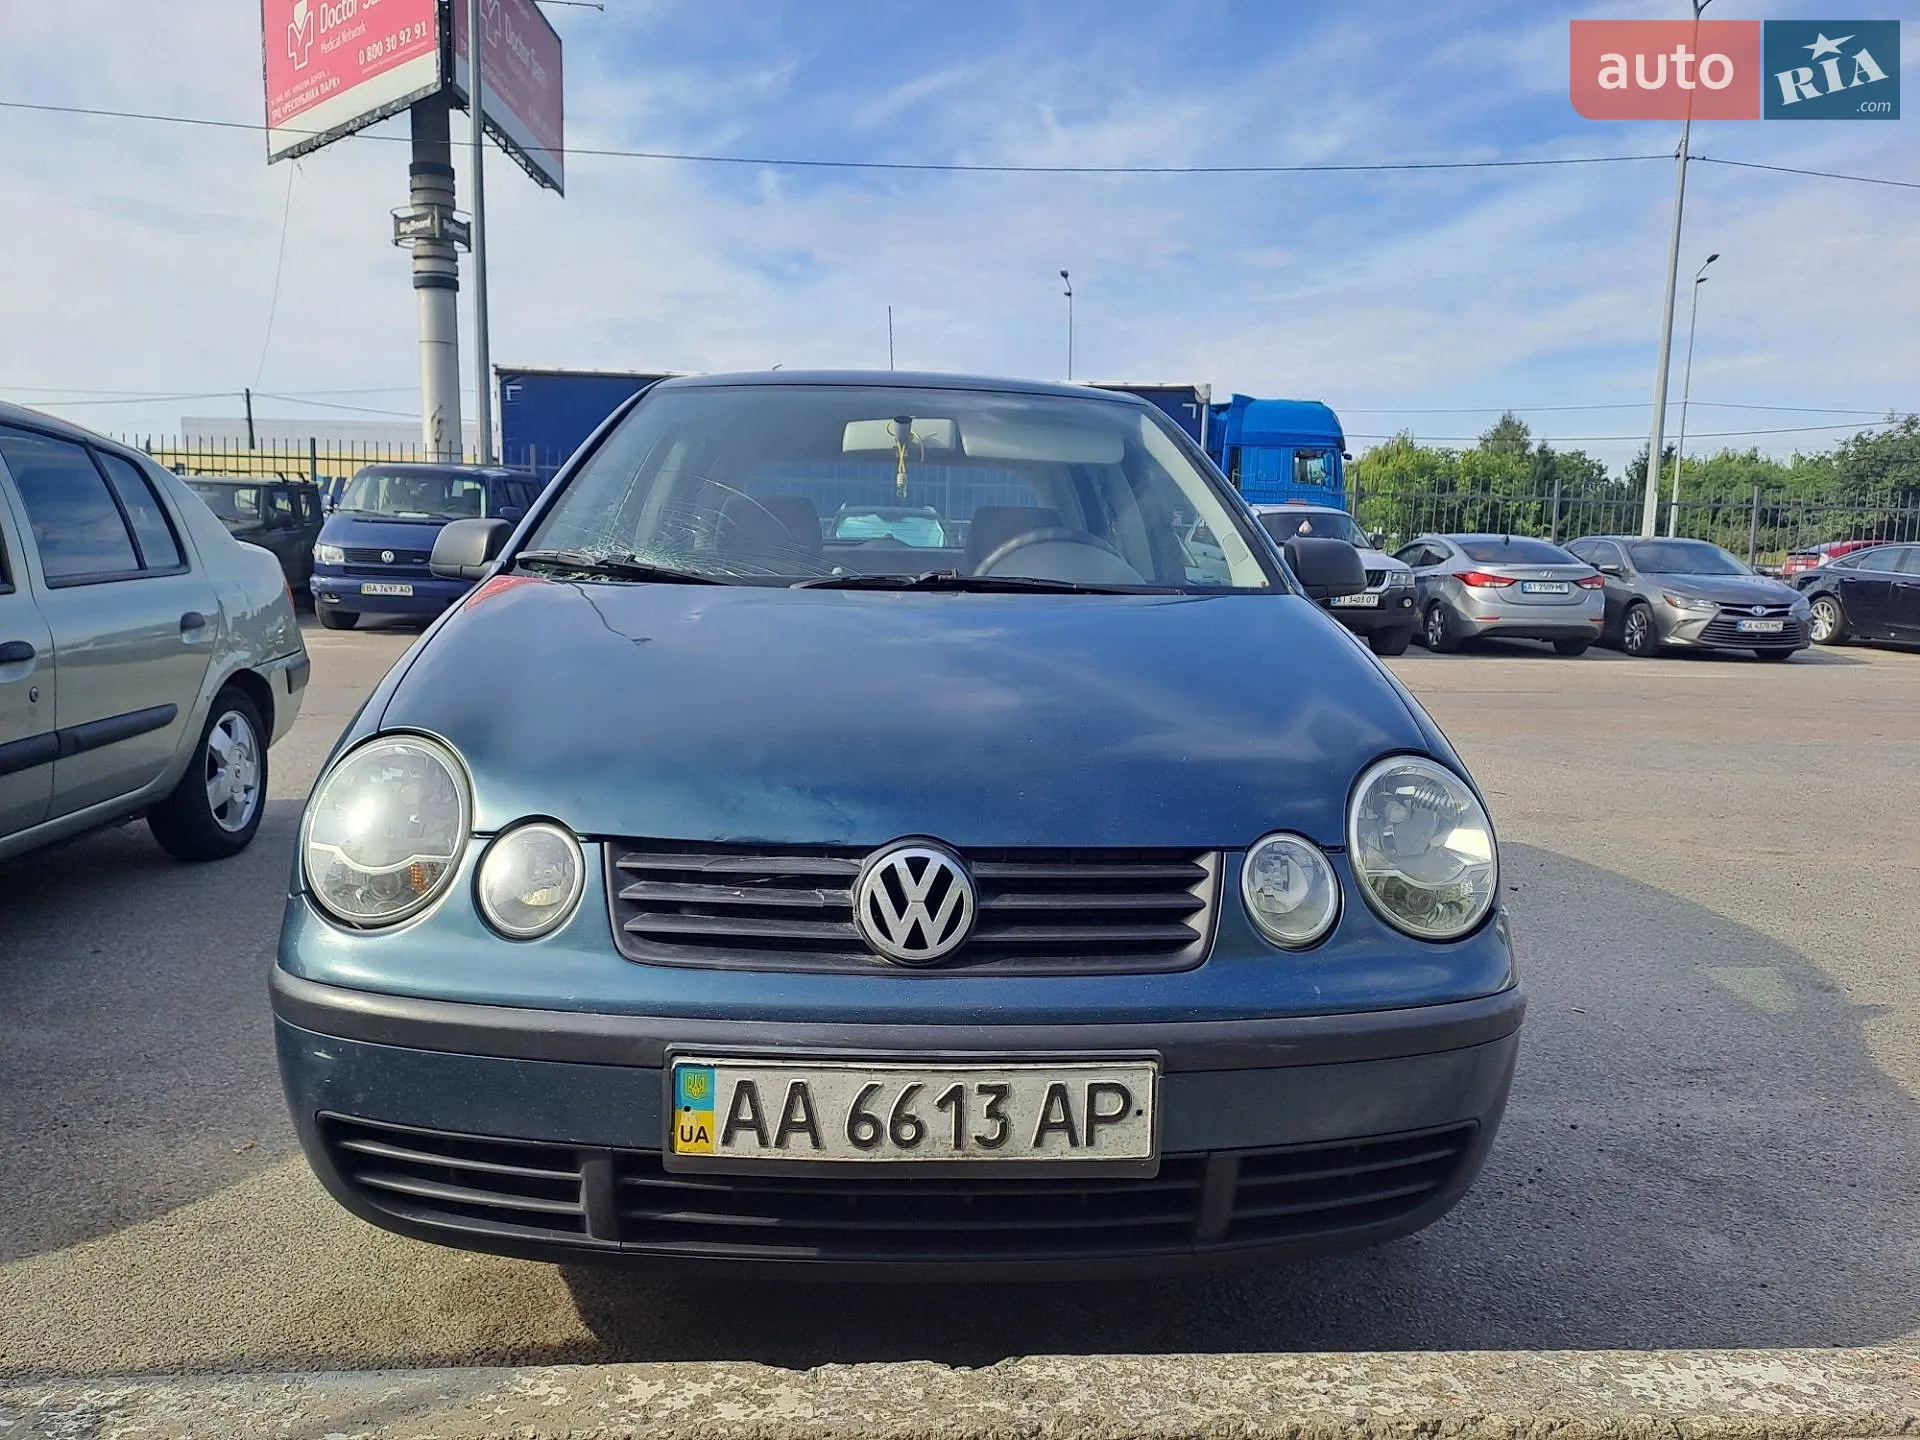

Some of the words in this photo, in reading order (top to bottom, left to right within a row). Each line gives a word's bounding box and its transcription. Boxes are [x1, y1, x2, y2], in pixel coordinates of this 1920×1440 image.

[320, 0, 358, 34] Doctor
[320, 32, 341, 55] Medical
[358, 48, 365, 66] 0
[366, 40, 384, 62] 800
[384, 33, 397, 53] 30
[399, 27, 412, 47] 92
[414, 20, 428, 40] 91
[719, 1079, 823, 1150] AA
[845, 1081, 1012, 1151] 6613
[1031, 1081, 1135, 1149] AP
[680, 1125, 710, 1144] UA
